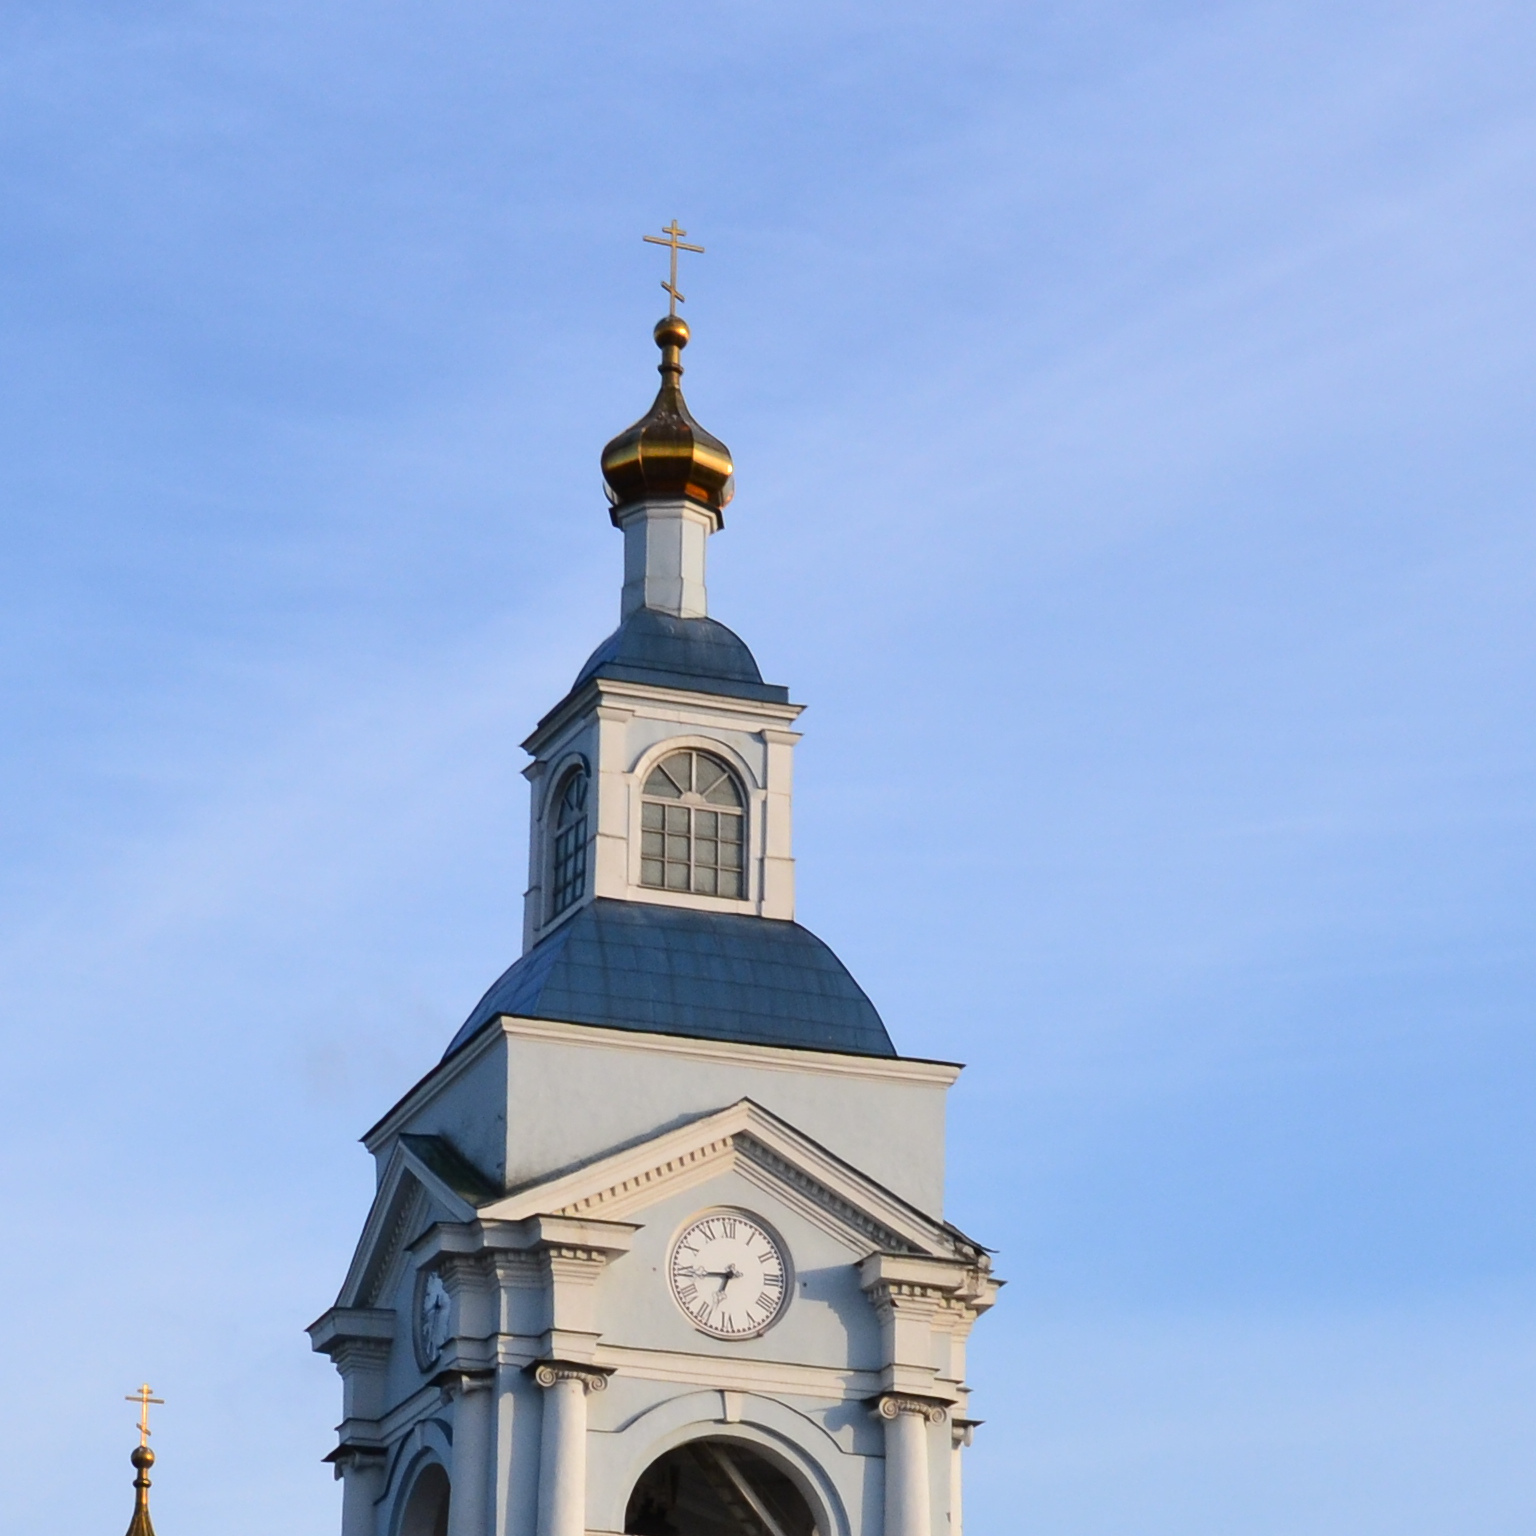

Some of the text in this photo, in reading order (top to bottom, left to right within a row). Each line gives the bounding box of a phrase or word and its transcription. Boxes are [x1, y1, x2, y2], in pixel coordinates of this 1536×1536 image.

[697, 1223, 716, 1244] XI
[722, 1221, 736, 1239] XII
[746, 1231, 756, 1246] I
[758, 1251, 774, 1264] II
[763, 1273, 779, 1287] III
